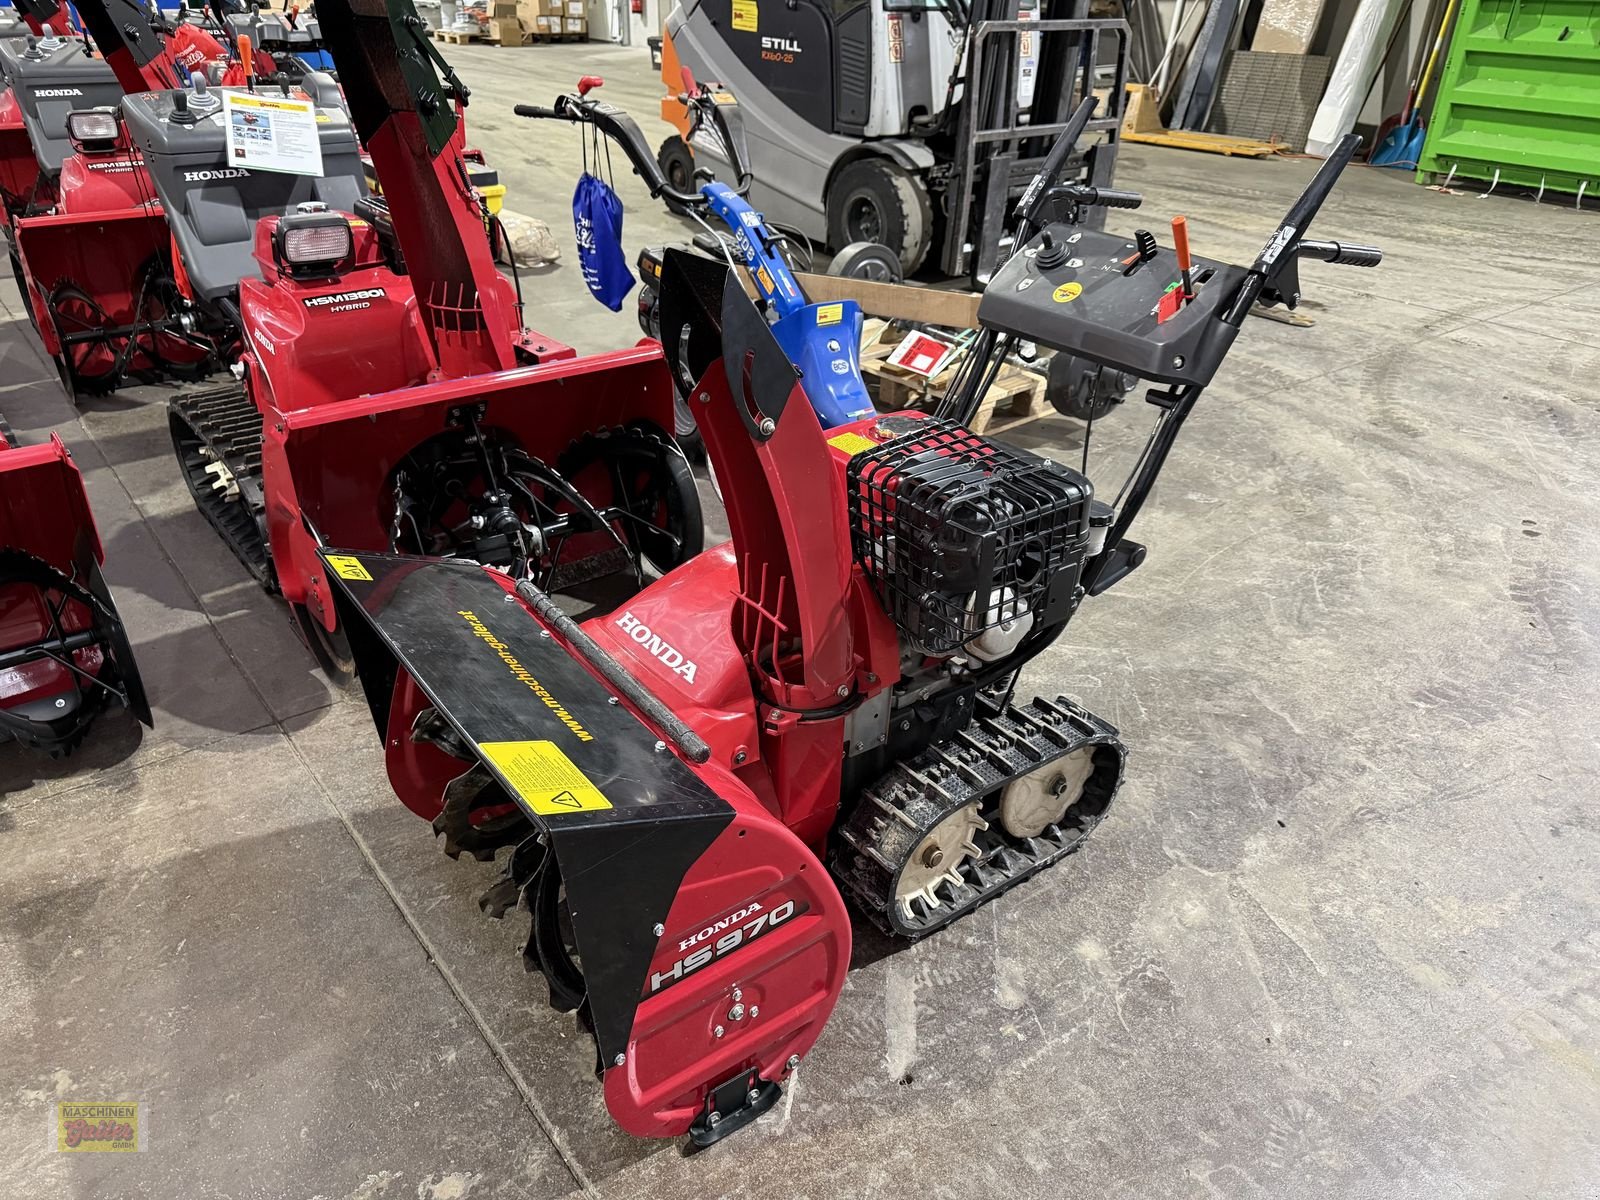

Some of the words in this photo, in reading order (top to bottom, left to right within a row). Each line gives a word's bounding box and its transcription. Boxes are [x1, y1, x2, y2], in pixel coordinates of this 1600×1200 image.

[761, 36, 802, 53] STILL
[34, 88, 83, 98] HONDA
[183, 168, 252, 182] HONDA
[330, 302, 371, 313] HYBRID
[254, 328, 276, 356] HONDA
[615, 611, 698, 685] HONDA
[678, 902, 763, 953] HONDA
